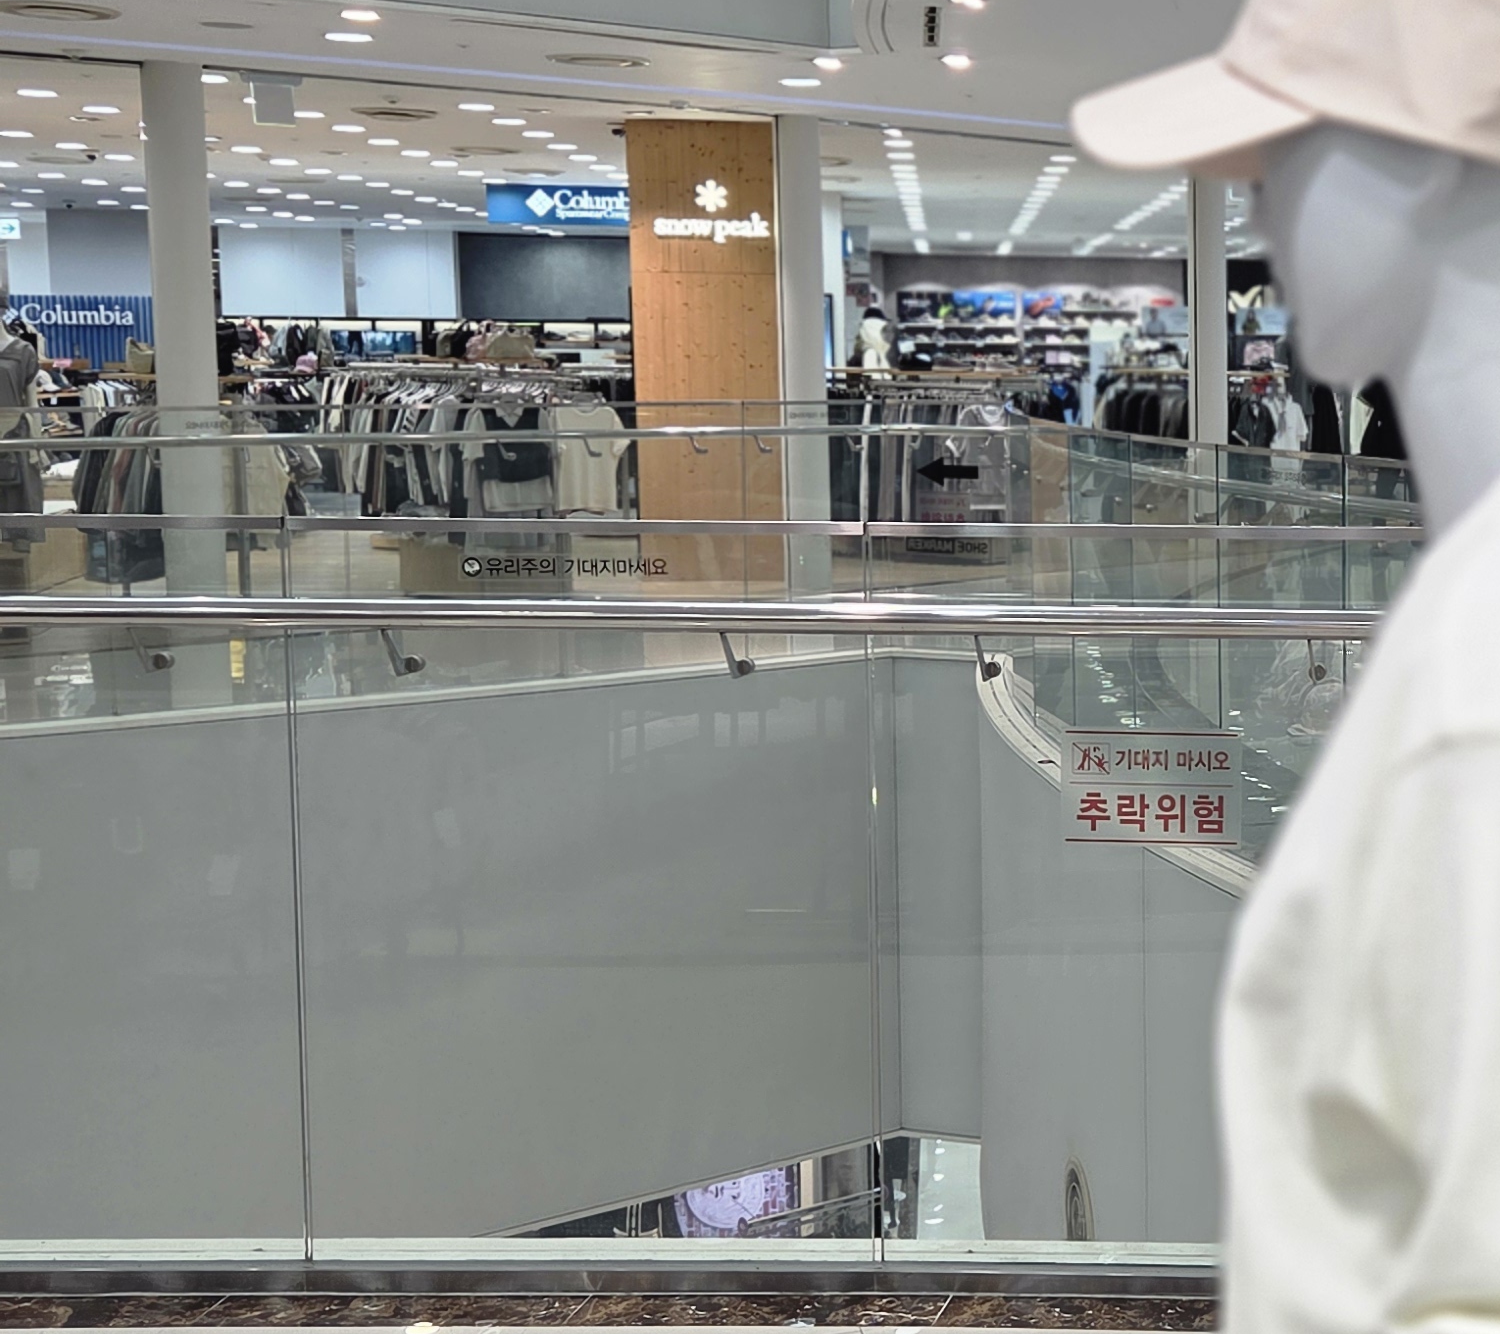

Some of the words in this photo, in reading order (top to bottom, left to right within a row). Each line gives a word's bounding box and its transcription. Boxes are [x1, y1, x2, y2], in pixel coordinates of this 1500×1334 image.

[653, 217, 713, 238] snow
[713, 211, 771, 244] peak
[19, 303, 135, 326] Columbia
[485, 557, 556, 577] 유리주의
[564, 557, 669, 577] 기대지마세요
[1115, 748, 1169, 771] 기대지
[1176, 749, 1232, 772] 마시오
[1076, 792, 1225, 834] 추락위험
